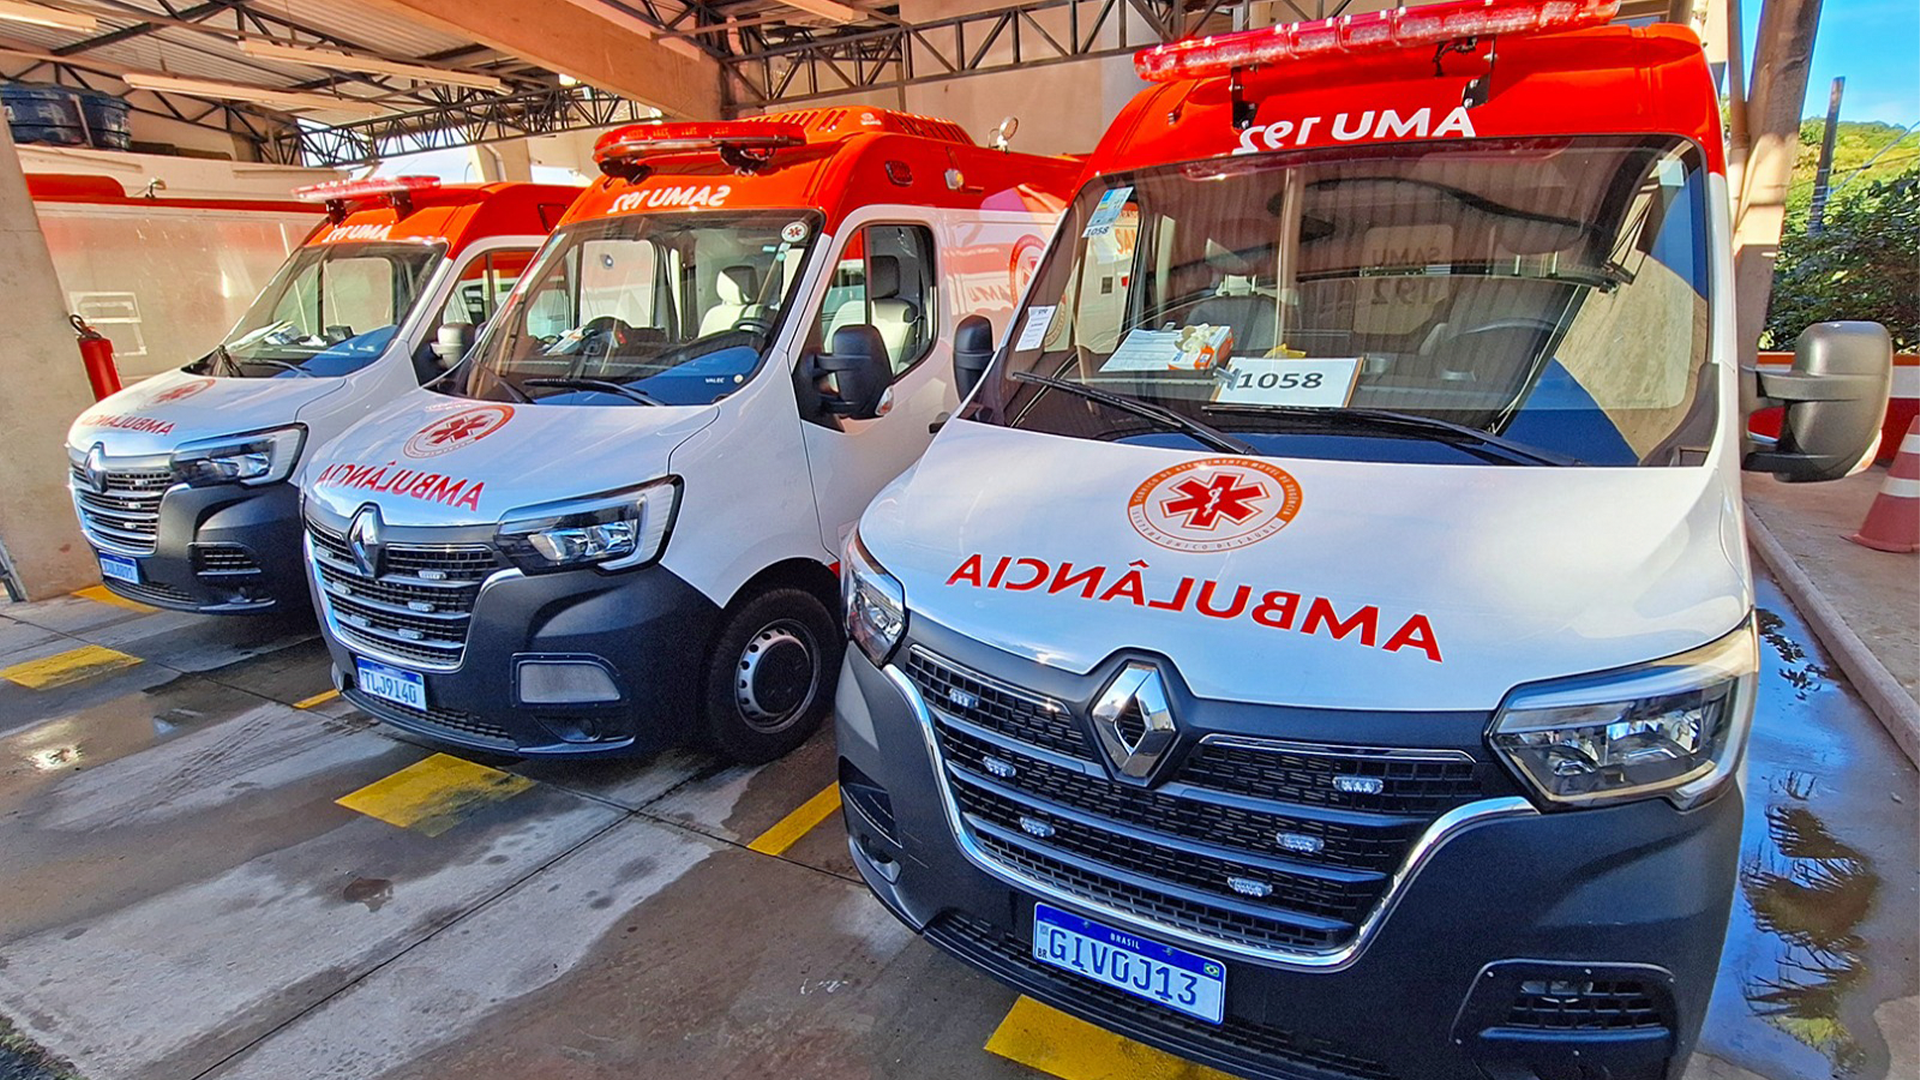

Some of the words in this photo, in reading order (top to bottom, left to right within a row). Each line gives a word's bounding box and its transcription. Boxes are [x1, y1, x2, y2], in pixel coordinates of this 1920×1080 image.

[1236, 372, 1323, 389] 1058
[1110, 932, 1140, 950] BRASIL
[1037, 948, 1048, 959] BR
